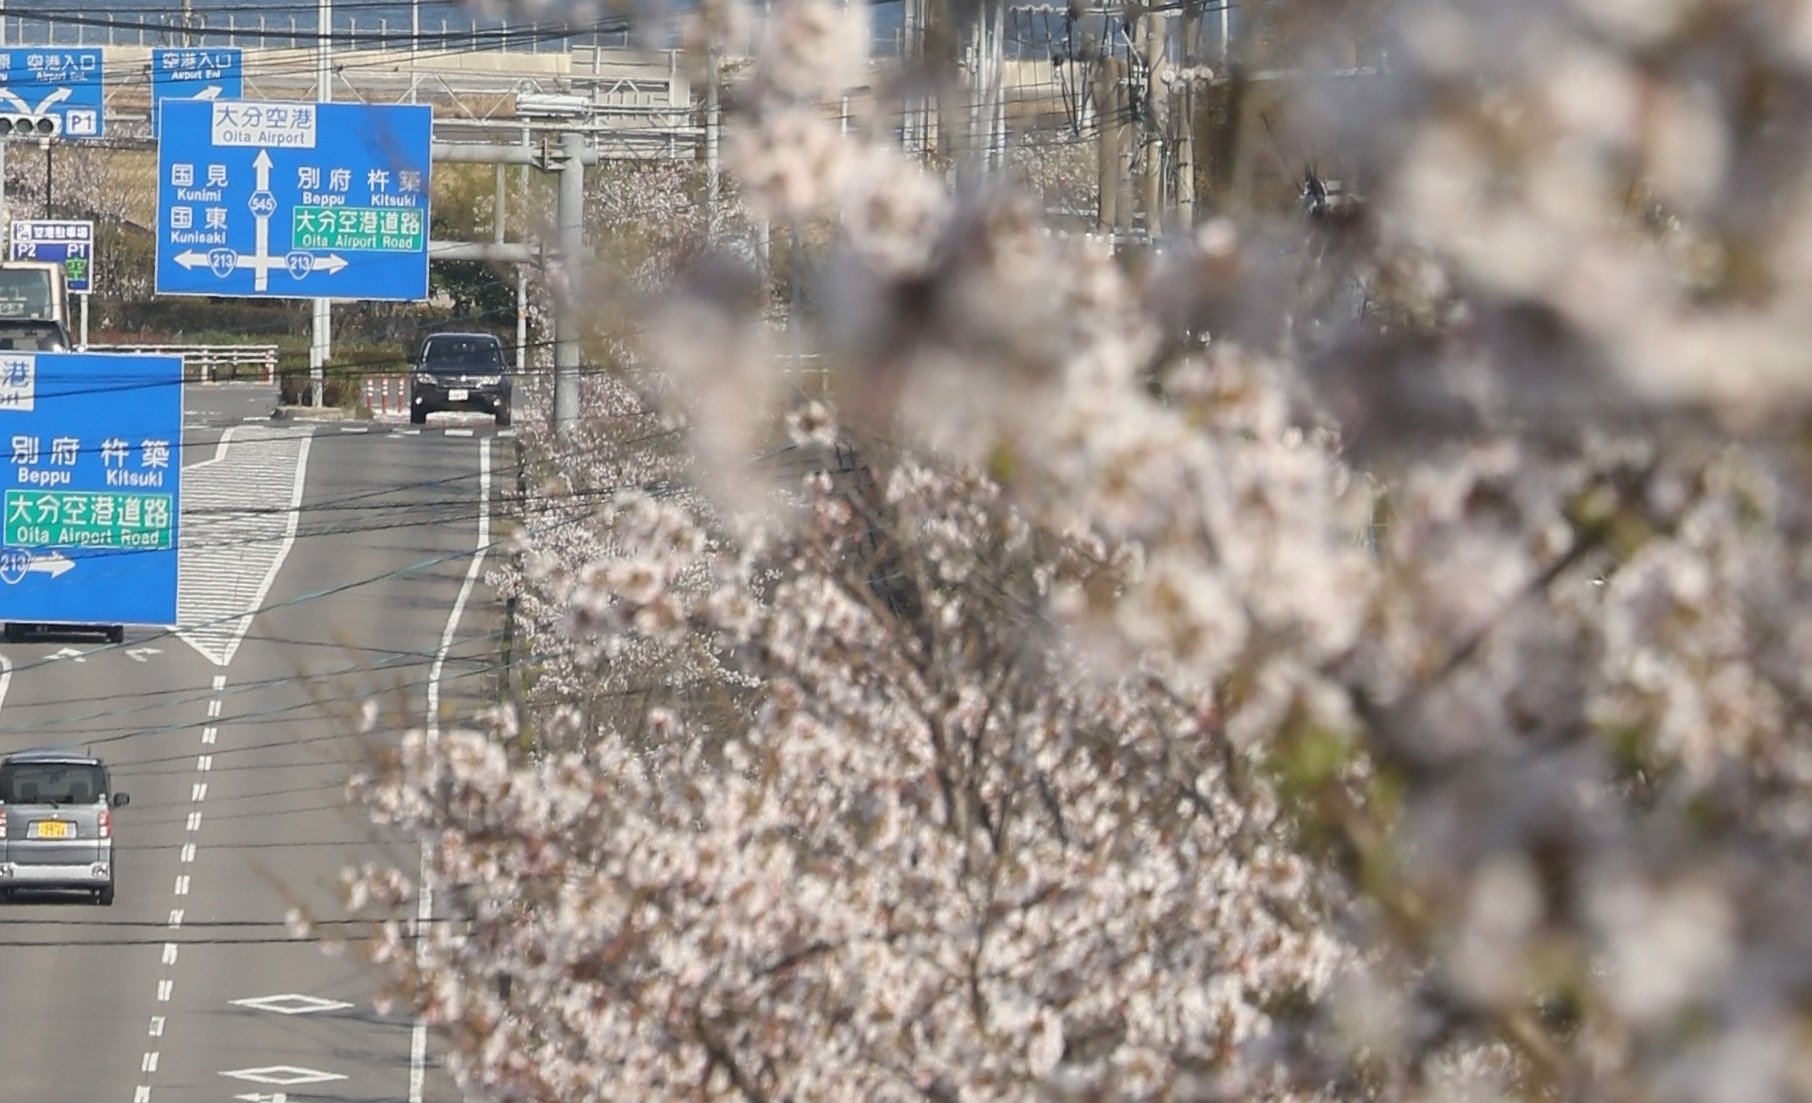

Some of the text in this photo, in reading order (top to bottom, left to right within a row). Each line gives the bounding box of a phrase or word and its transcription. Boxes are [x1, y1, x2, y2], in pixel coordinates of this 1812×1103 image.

[27, 54, 96, 71] 空港入口
[163, 53, 232, 69] 空港入口
[36, 71, 66, 84] Airport
[171, 69, 202, 80] Airport
[72, 114, 92, 131] P1
[216, 105, 311, 129] 大分空港
[223, 130, 305, 147] Oita Airport
[172, 164, 228, 187] 国見
[298, 167, 351, 192] 別府
[367, 169, 421, 192] 杵築
[177, 188, 222, 202] Kunimi
[303, 192, 345, 207] Beppu
[371, 194, 416, 207] Kitsuki
[251, 199, 273, 211] 545
[171, 206, 228, 230] 国東
[297, 210, 420, 235] 大分空港道路
[171, 231, 226, 245] Kunisaki
[302, 234, 413, 249] Oita Airport Road
[18, 244, 36, 257] P2
[67, 244, 85, 257] P1
[212, 254, 233, 267] 213
[290, 257, 309, 270] 213
[10, 436, 80, 466] 別府
[101, 437, 170, 468] 杵築
[18, 467, 70, 487] Beppu
[107, 469, 162, 487] Kitsuki
[9, 494, 169, 528] 大分空港道路
[17, 527, 159, 545] Oita Airport Road
[0, 555, 25, 571] 213
